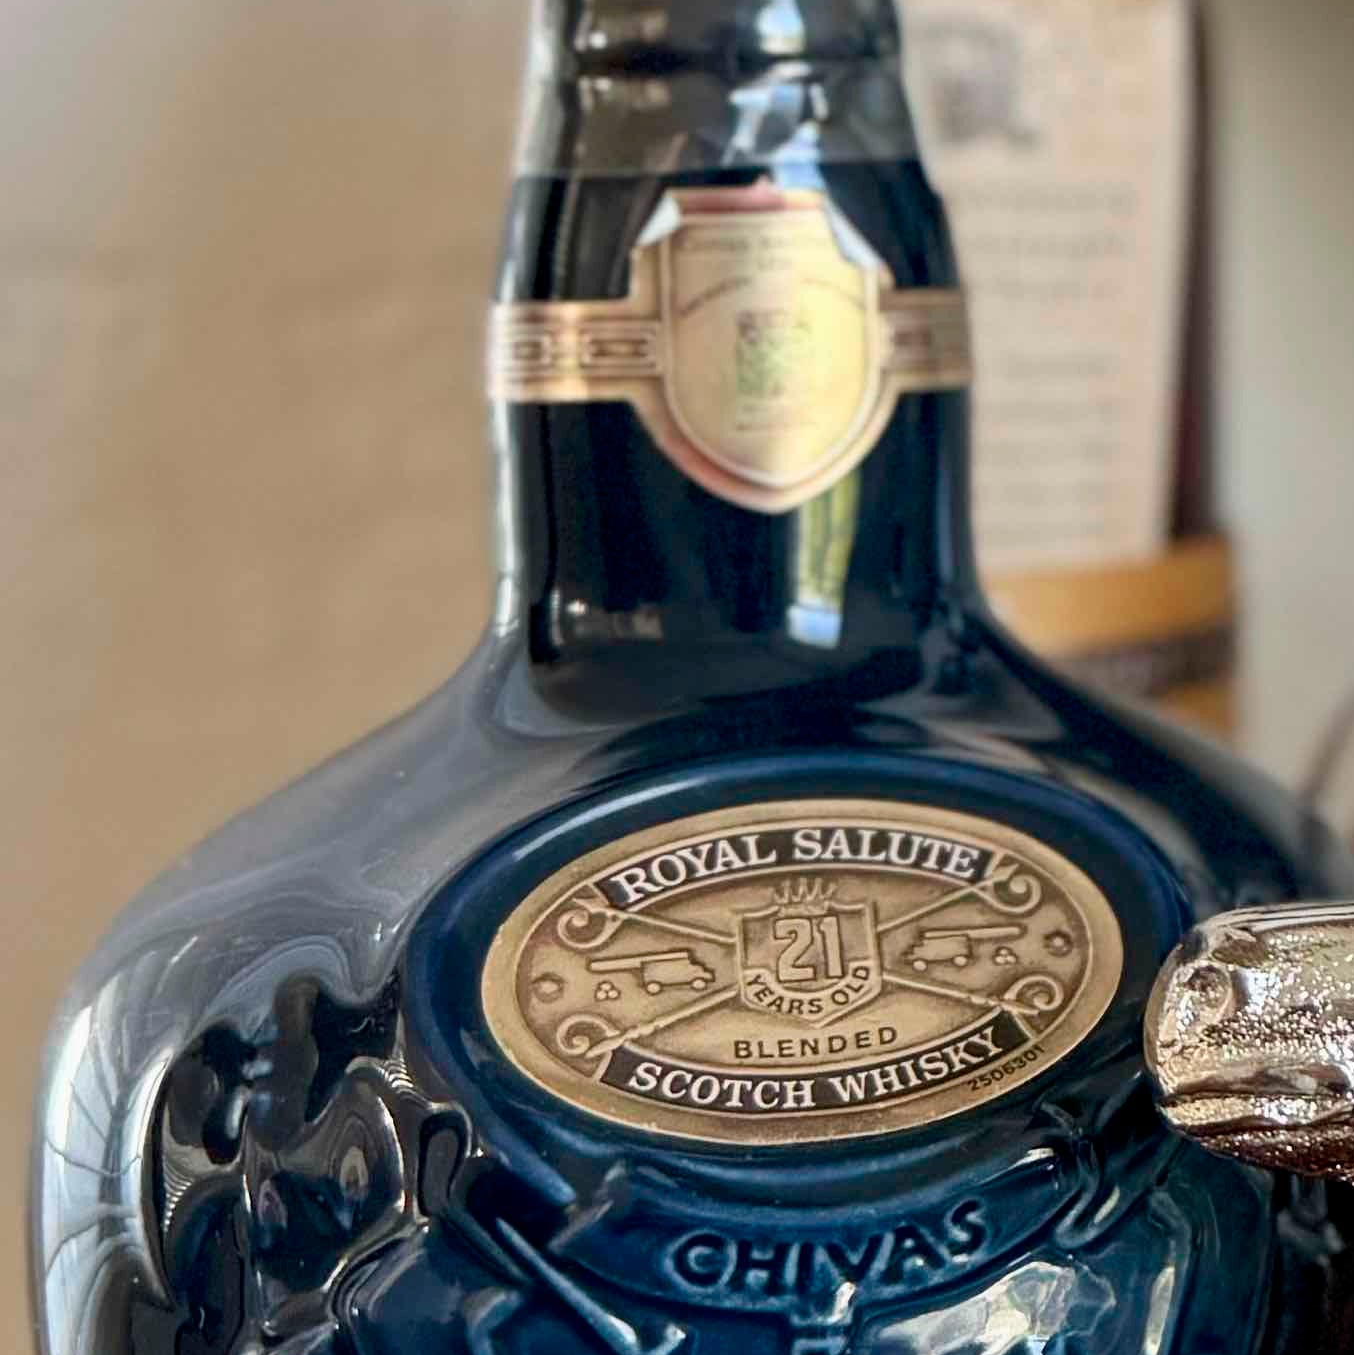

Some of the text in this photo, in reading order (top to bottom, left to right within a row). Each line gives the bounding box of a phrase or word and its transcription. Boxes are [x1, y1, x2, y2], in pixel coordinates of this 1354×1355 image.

[609, 828, 982, 904] ROYAL SALUTE
[773, 915, 846, 983] 21
[747, 965, 870, 1015] YEARS OLD
[627, 1025, 1004, 1109] SCOTCH WHISKY
[733, 1026, 897, 1059] BLENDED
[670, 1198, 988, 1296] CHIVAS
